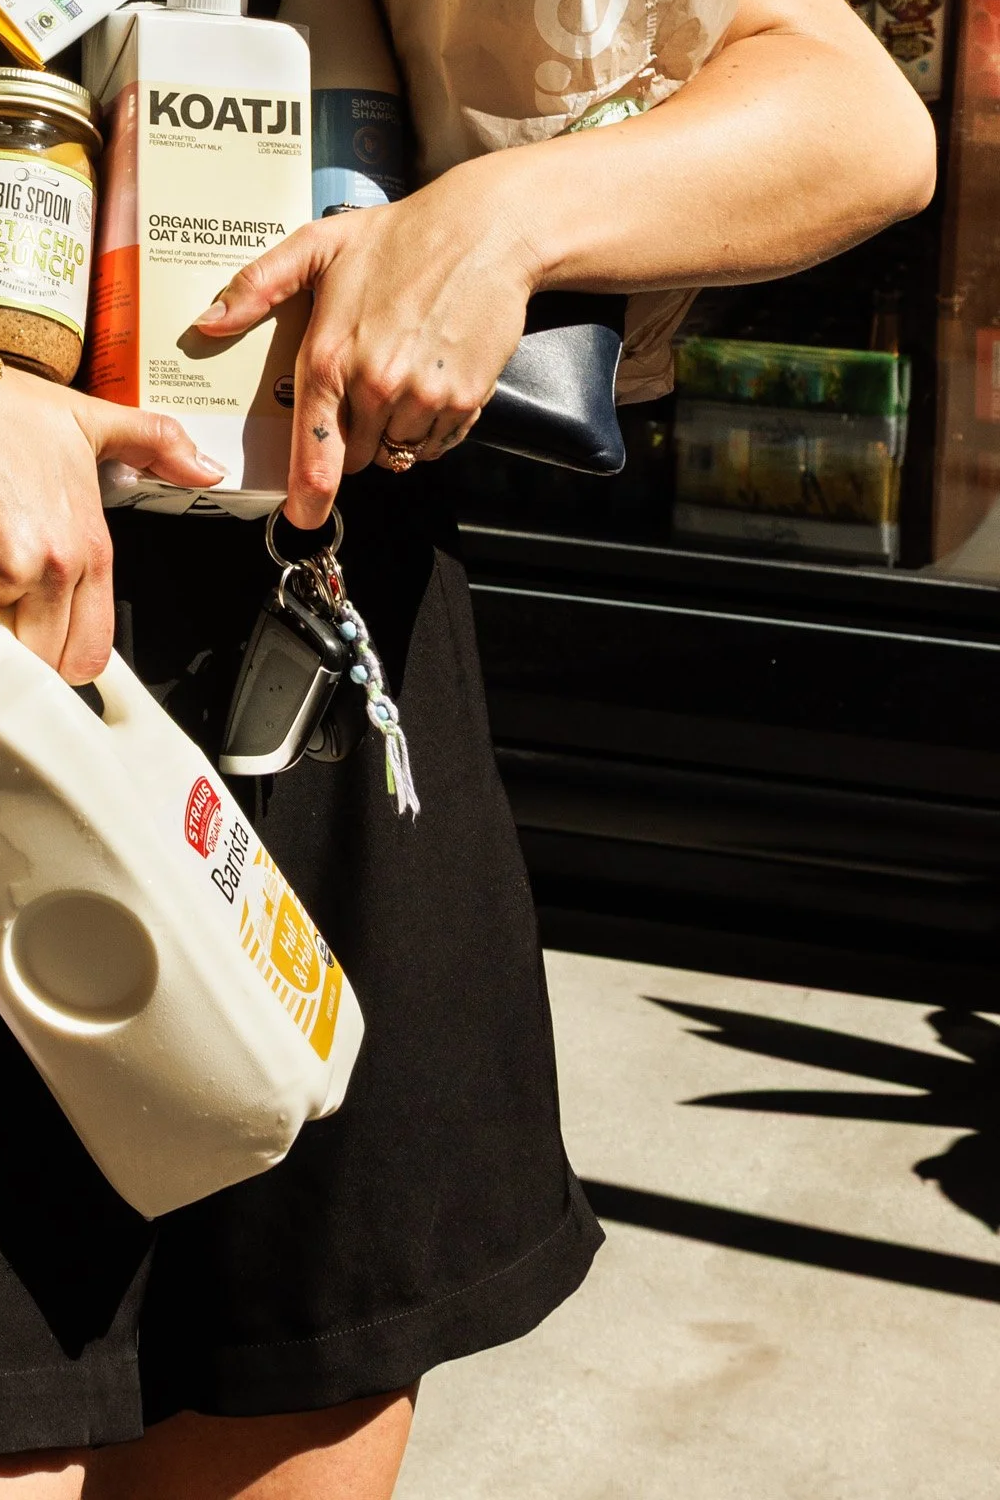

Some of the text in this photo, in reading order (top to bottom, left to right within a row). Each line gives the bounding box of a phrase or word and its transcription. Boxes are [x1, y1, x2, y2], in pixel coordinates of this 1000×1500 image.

[149, 90, 302, 136] KOATJI
[149, 132, 197, 142] SLOW CRAFTED
[149, 139, 223, 152] FERMENTED PLANT MILK
[257, 141, 302, 150] COPENHAGEN
[272, 149, 302, 157] ANGELES
[25, 186, 72, 226] SPOON
[13, 211, 53, 227] ROASTERS
[149, 214, 286, 236] ORGANIC BARISTA
[149, 228, 267, 248] OAT & KOJI MILK
[211, 252, 245, 260] fermented
[149, 395, 240, 407] 32 FL OZ 946 ML
[188, 783, 212, 844] STRAUS
[207, 810, 223, 853] ORGANIC
[210, 820, 249, 905] Barista
[279, 910, 298, 960] Half
[293, 927, 313, 988] & Half
